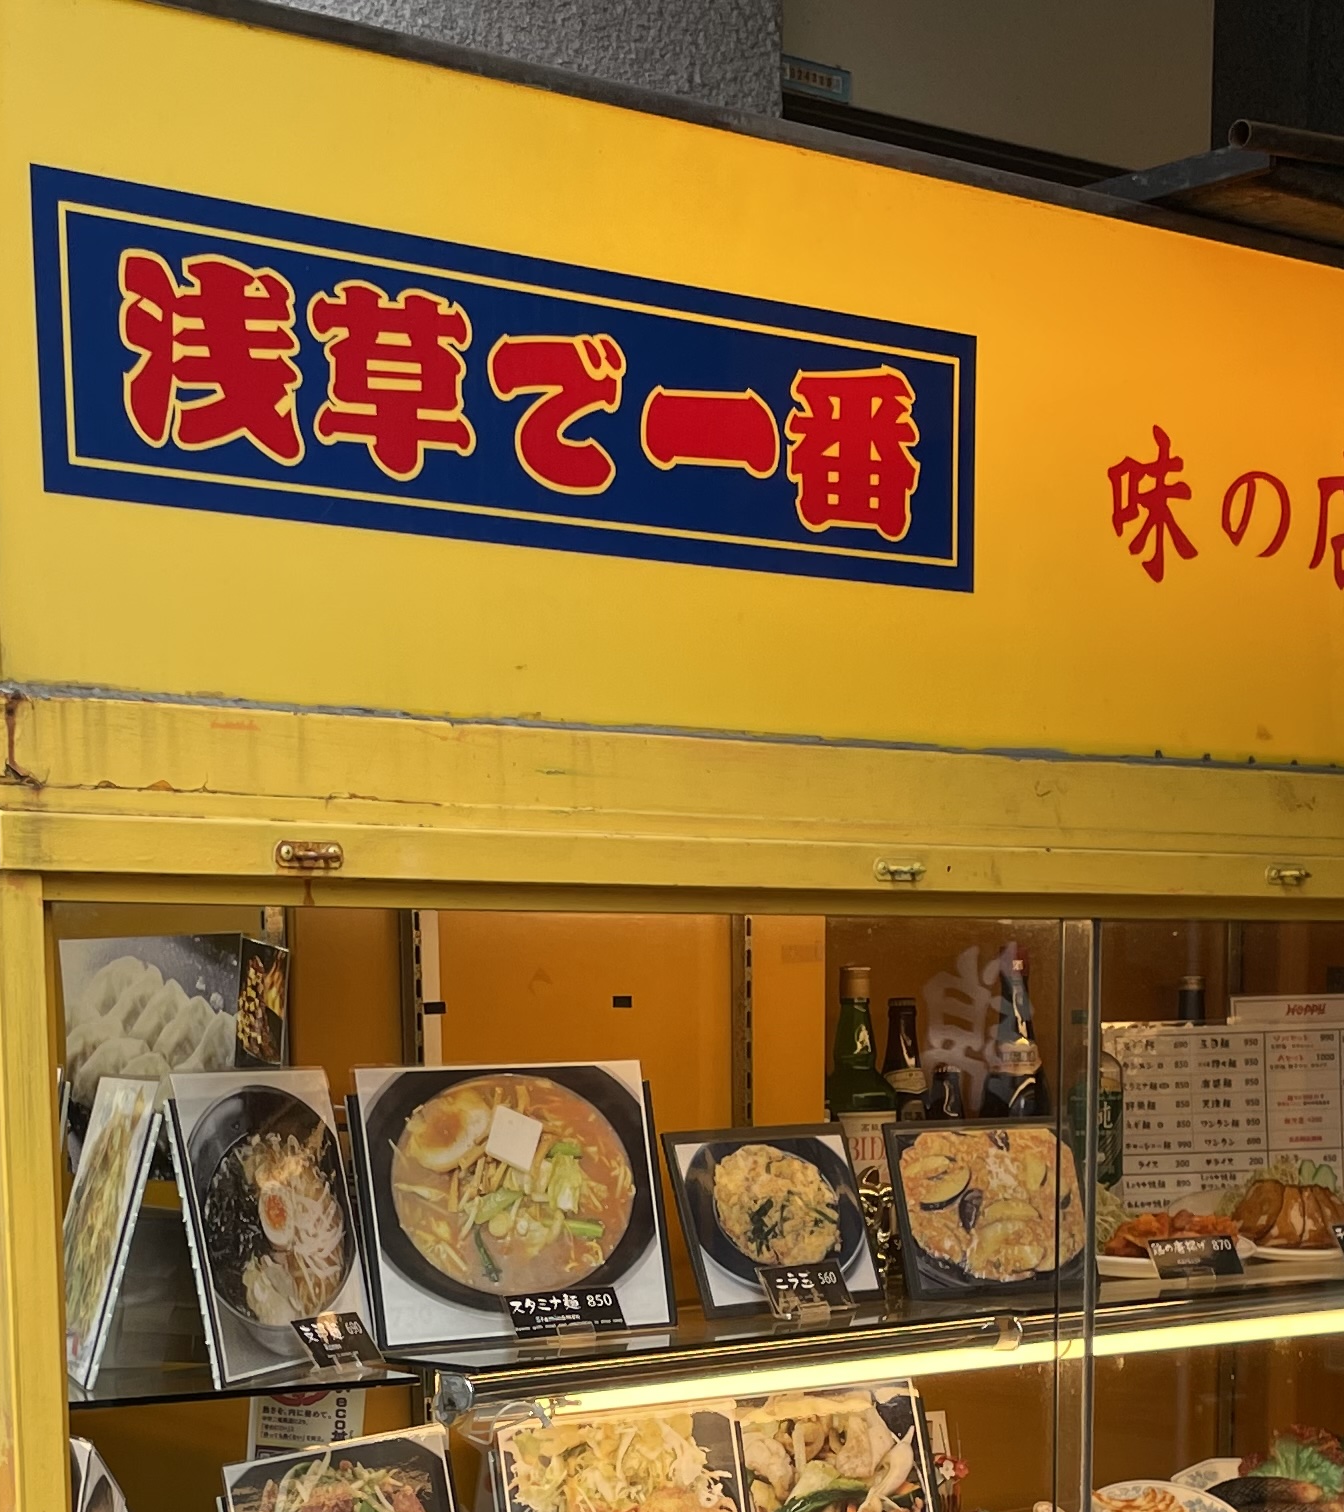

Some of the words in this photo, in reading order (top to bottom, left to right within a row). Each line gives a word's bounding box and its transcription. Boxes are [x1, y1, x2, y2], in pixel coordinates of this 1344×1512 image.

[117, 248, 920, 541] 浅草で一番
[1211, 1239, 1232, 1251] 870
[510, 1292, 581, 1316] スタミナ麺
[586, 1293, 613, 1307] 850
